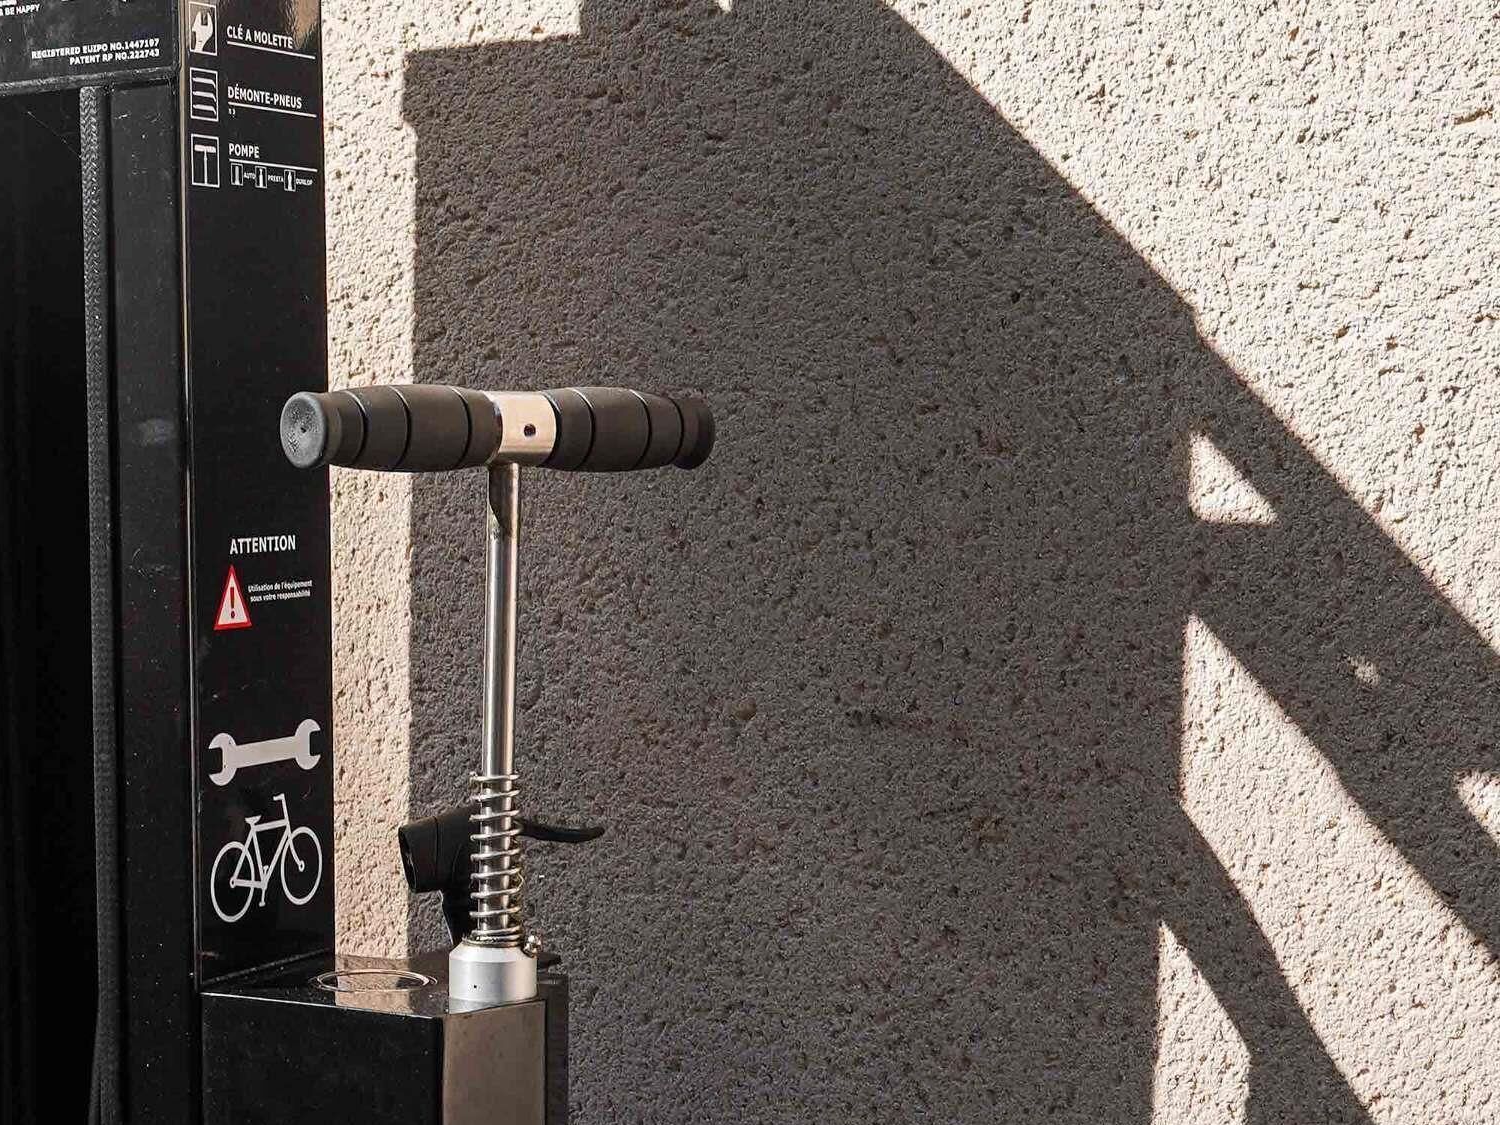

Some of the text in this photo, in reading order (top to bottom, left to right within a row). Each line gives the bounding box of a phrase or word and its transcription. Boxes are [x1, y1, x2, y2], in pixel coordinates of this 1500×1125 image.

[5, 6, 15, 16] BE
[16, 3, 40, 14] HAPPY
[227, 24, 243, 40] CLÉ
[254, 30, 294, 49] MOLETTE
[32, 46, 80, 59] REGISTERED
[69, 54, 100, 65] PATENT
[228, 83, 302, 109] DÉMONTE-PNEUS
[229, 143, 260, 159] POMPE
[229, 534, 296, 555] ATTENTION
